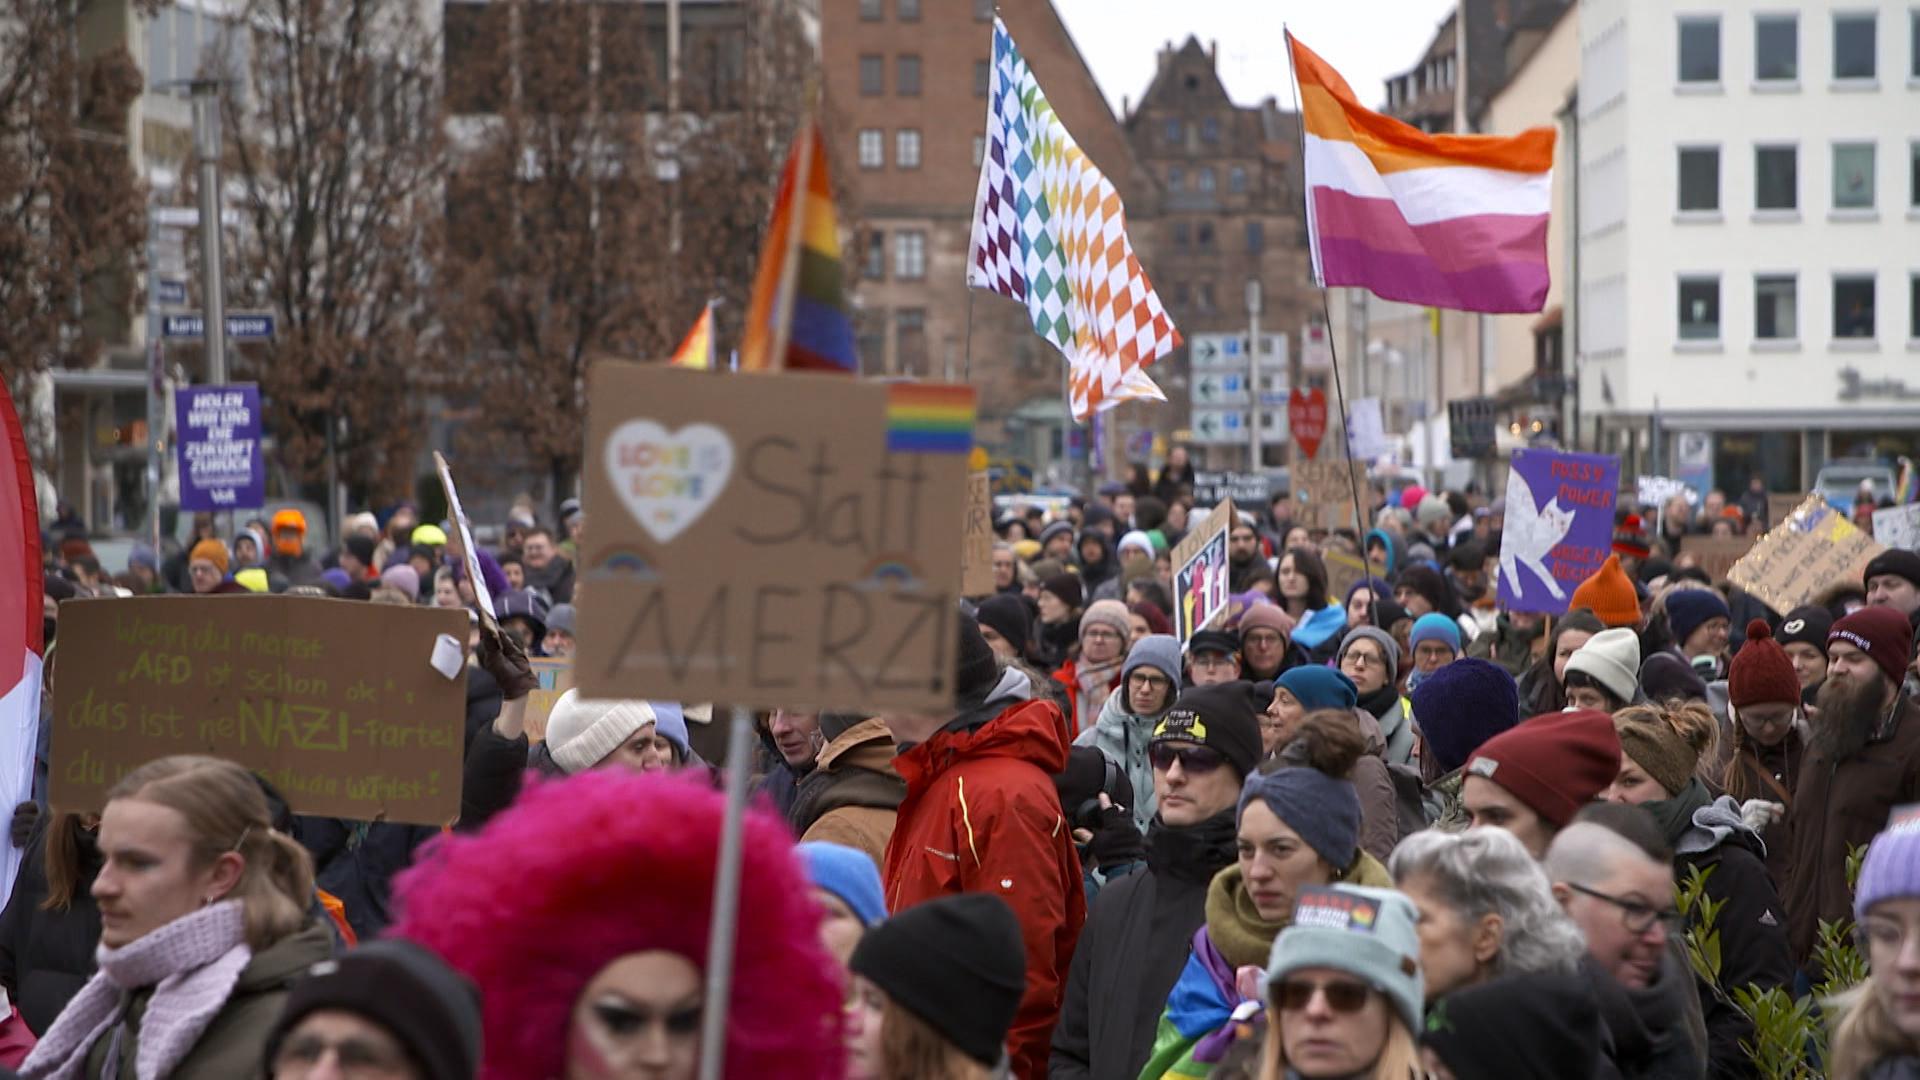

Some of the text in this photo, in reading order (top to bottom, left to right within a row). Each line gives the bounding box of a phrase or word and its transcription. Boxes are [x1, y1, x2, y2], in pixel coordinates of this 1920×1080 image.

[193, 392, 244, 408] HOLEN
[221, 407, 251, 426] UNS
[185, 440, 255, 460] ZUKUNFT
[1558, 483, 1612, 508] POWER
[242, 664, 329, 696] schon
[68, 687, 129, 732] das
[139, 703, 185, 739] ist
